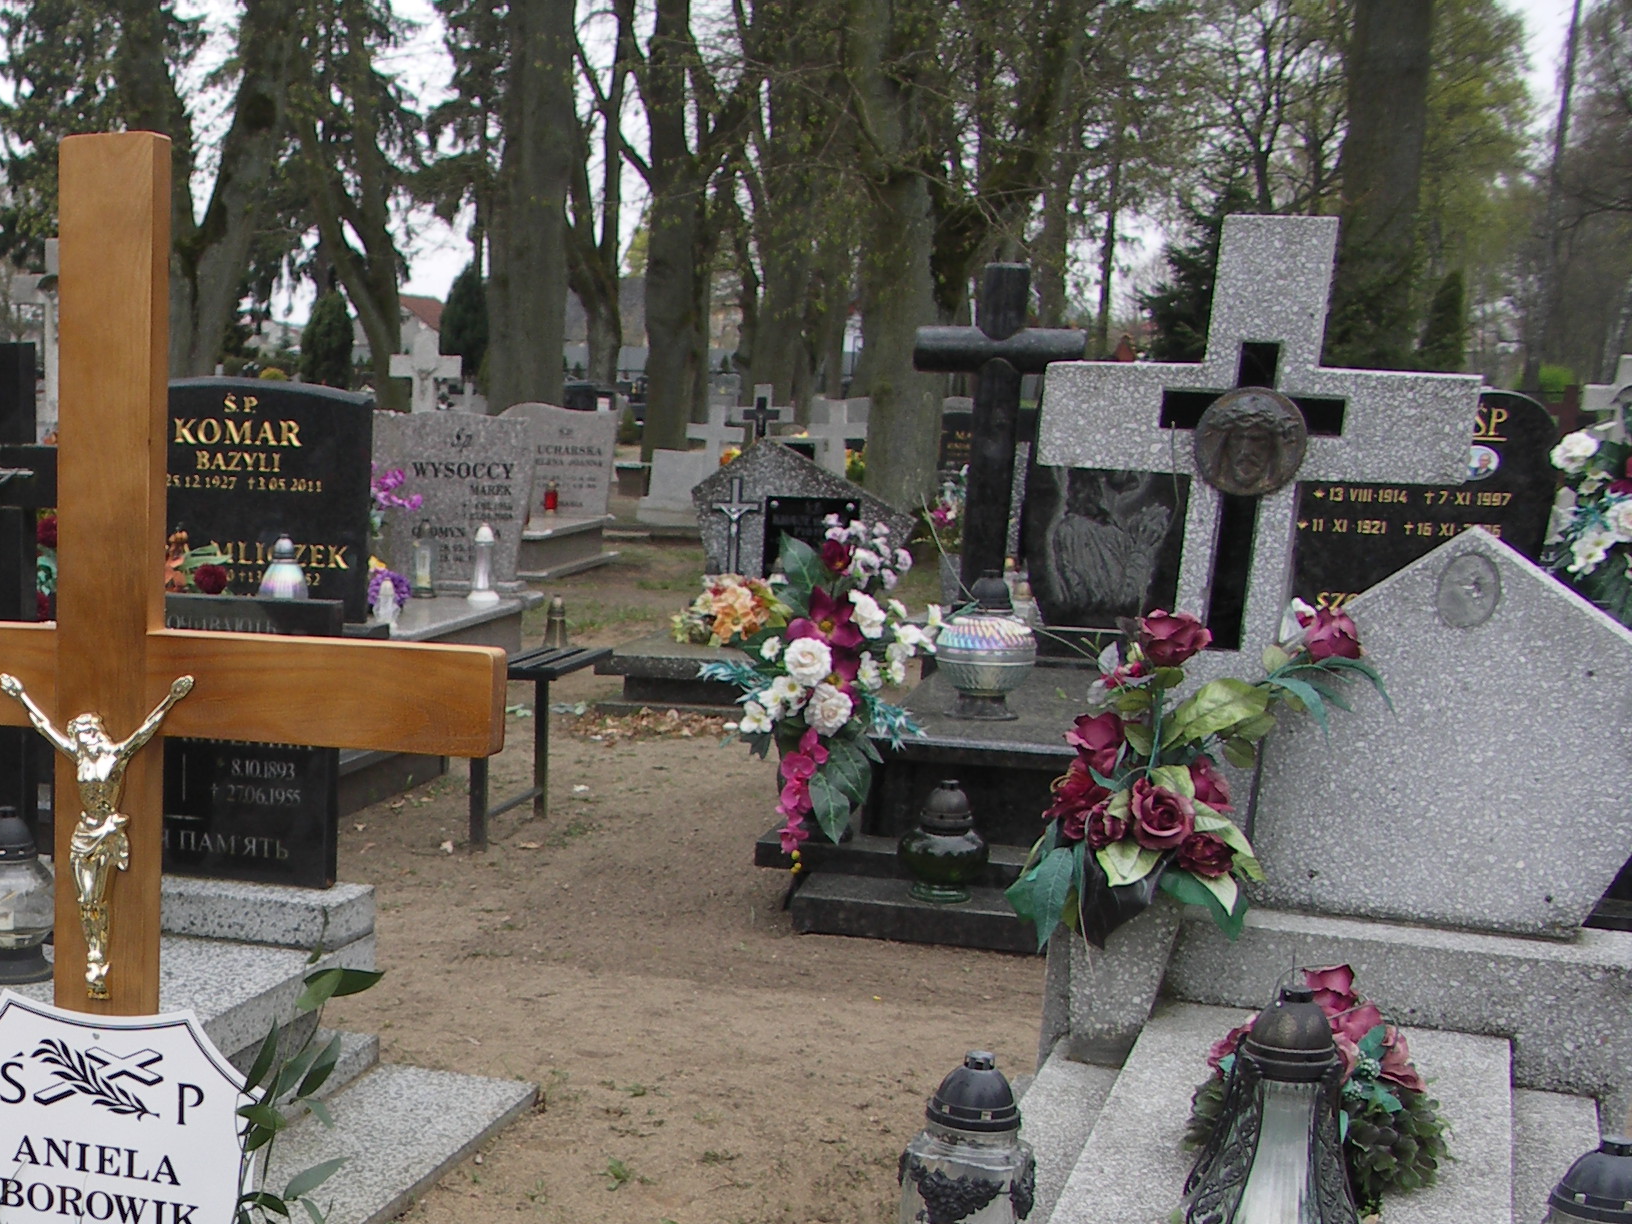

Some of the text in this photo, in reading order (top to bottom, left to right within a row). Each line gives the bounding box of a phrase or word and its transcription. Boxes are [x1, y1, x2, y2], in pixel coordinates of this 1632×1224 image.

[173, 418, 304, 447] KOMAR
[537, 445, 602, 456] UCHARSKA
[196, 450, 281, 472] BAZYLI
[411, 462, 515, 480] WYSOCCY
[470, 484, 513, 496] MAREK
[12, 1135, 181, 1186] ANIELA
